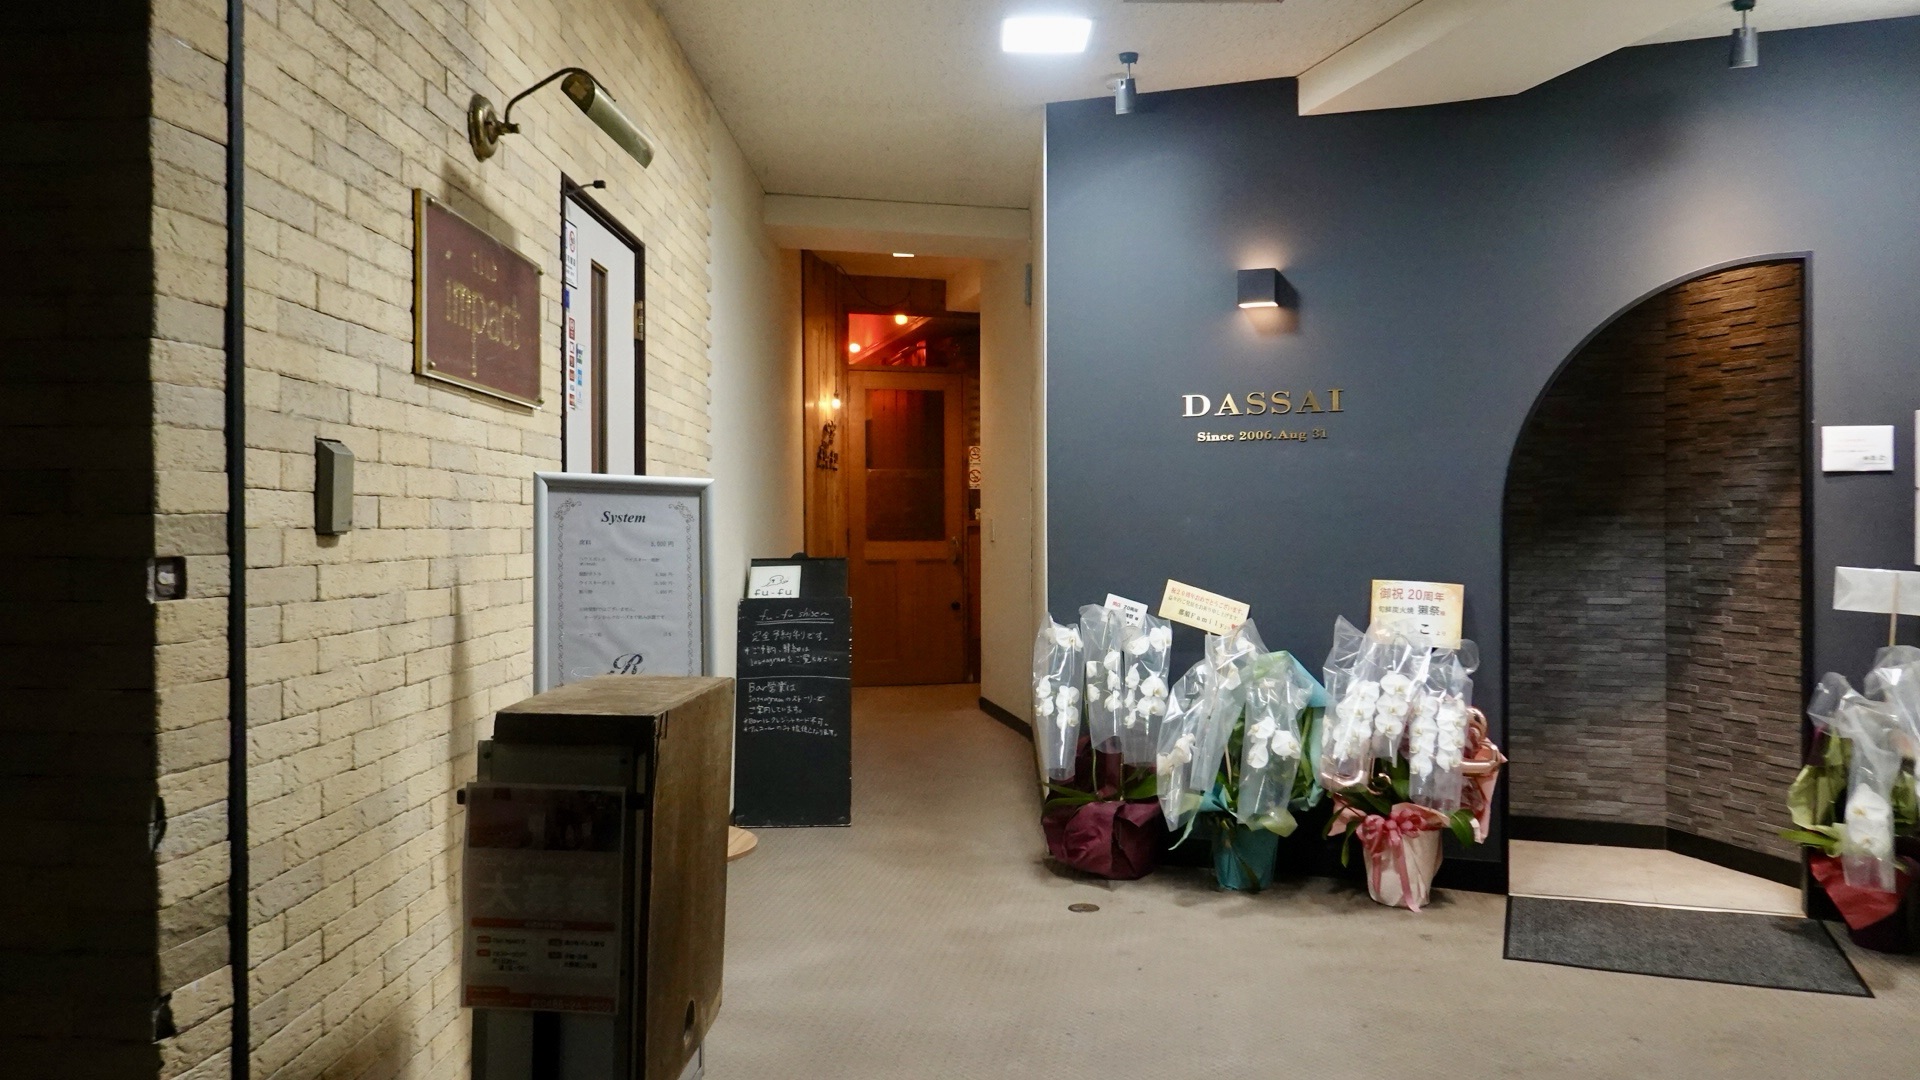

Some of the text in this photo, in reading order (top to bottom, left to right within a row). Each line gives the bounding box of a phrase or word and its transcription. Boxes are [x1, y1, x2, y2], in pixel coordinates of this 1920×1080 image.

[1181, 388, 1345, 418] DASSAI
[1197, 428, 1328, 442] Since 2006.Aug 31
[601, 510, 647, 526] System
[1379, 587, 1445, 603] 御祝 20周年
[748, 681, 796, 694] Bar営業は
